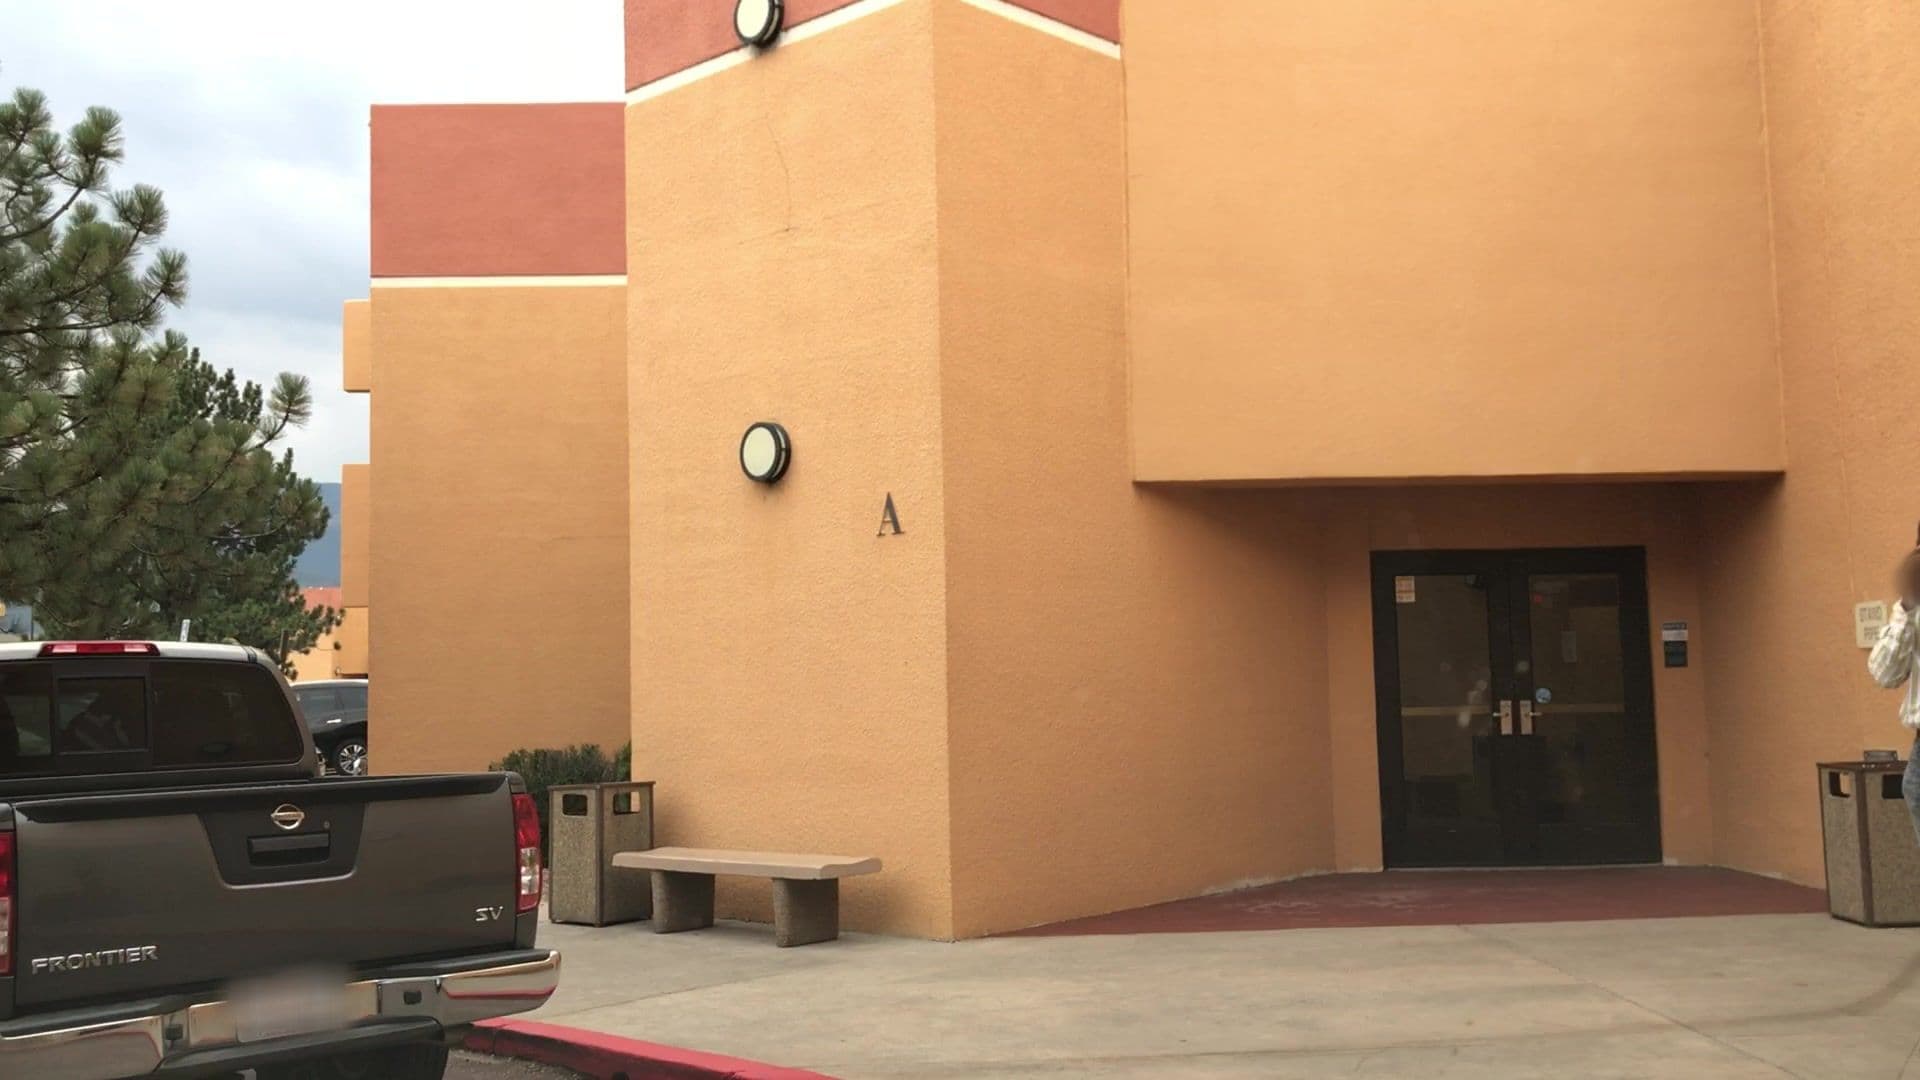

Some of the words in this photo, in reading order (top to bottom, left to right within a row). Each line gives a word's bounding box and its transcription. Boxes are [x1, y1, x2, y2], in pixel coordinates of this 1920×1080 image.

[876, 491, 905, 537] A
[475, 906, 503, 921] SV
[31, 945, 158, 974] FRONTIER
